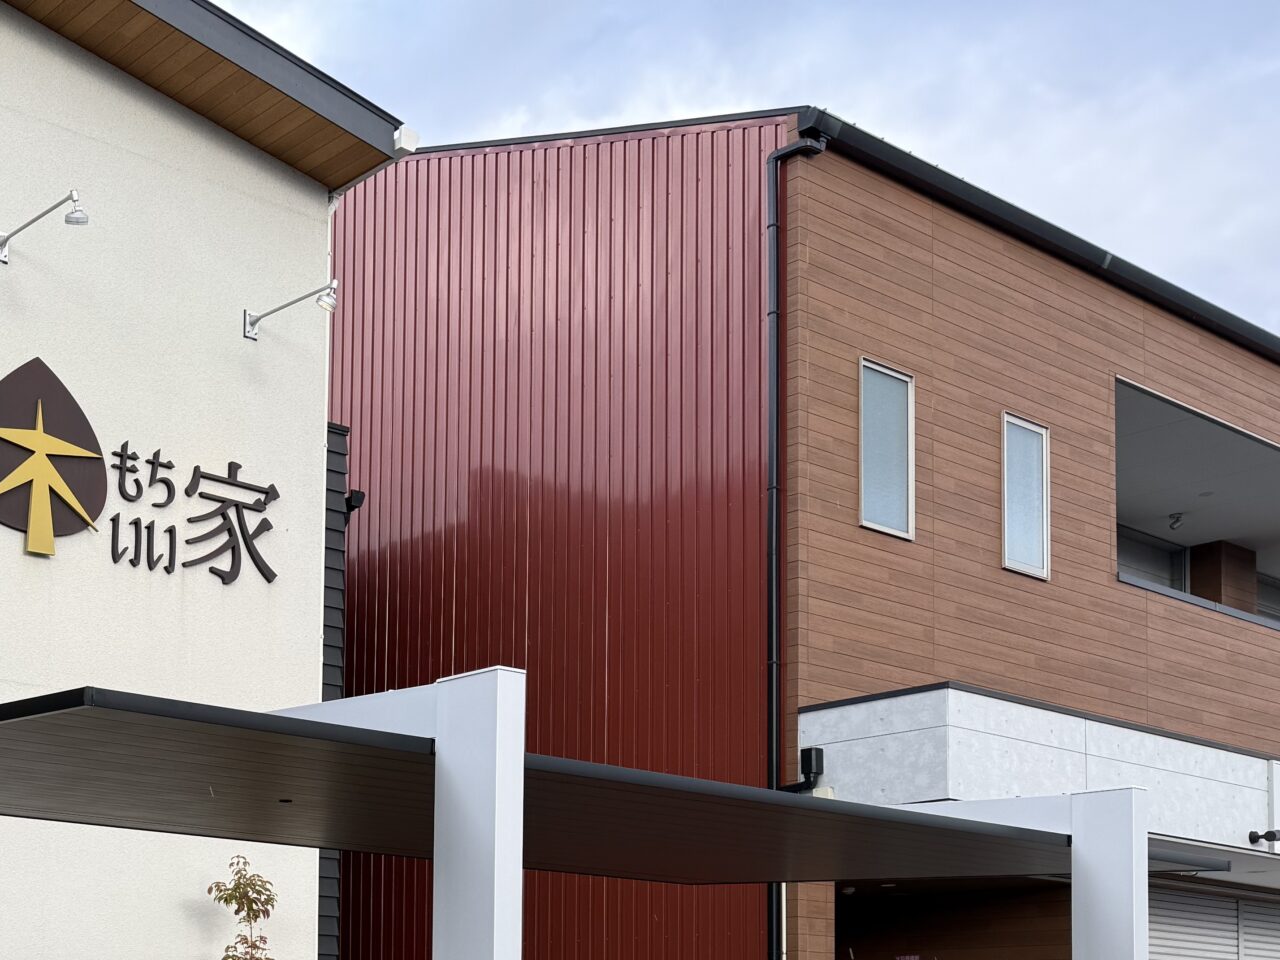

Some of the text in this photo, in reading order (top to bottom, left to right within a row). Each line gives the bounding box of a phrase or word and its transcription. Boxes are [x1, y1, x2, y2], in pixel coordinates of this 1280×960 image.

[111, 440, 176, 508] もち
[110, 512, 177, 575] いい
[181, 461, 281, 585] 家
